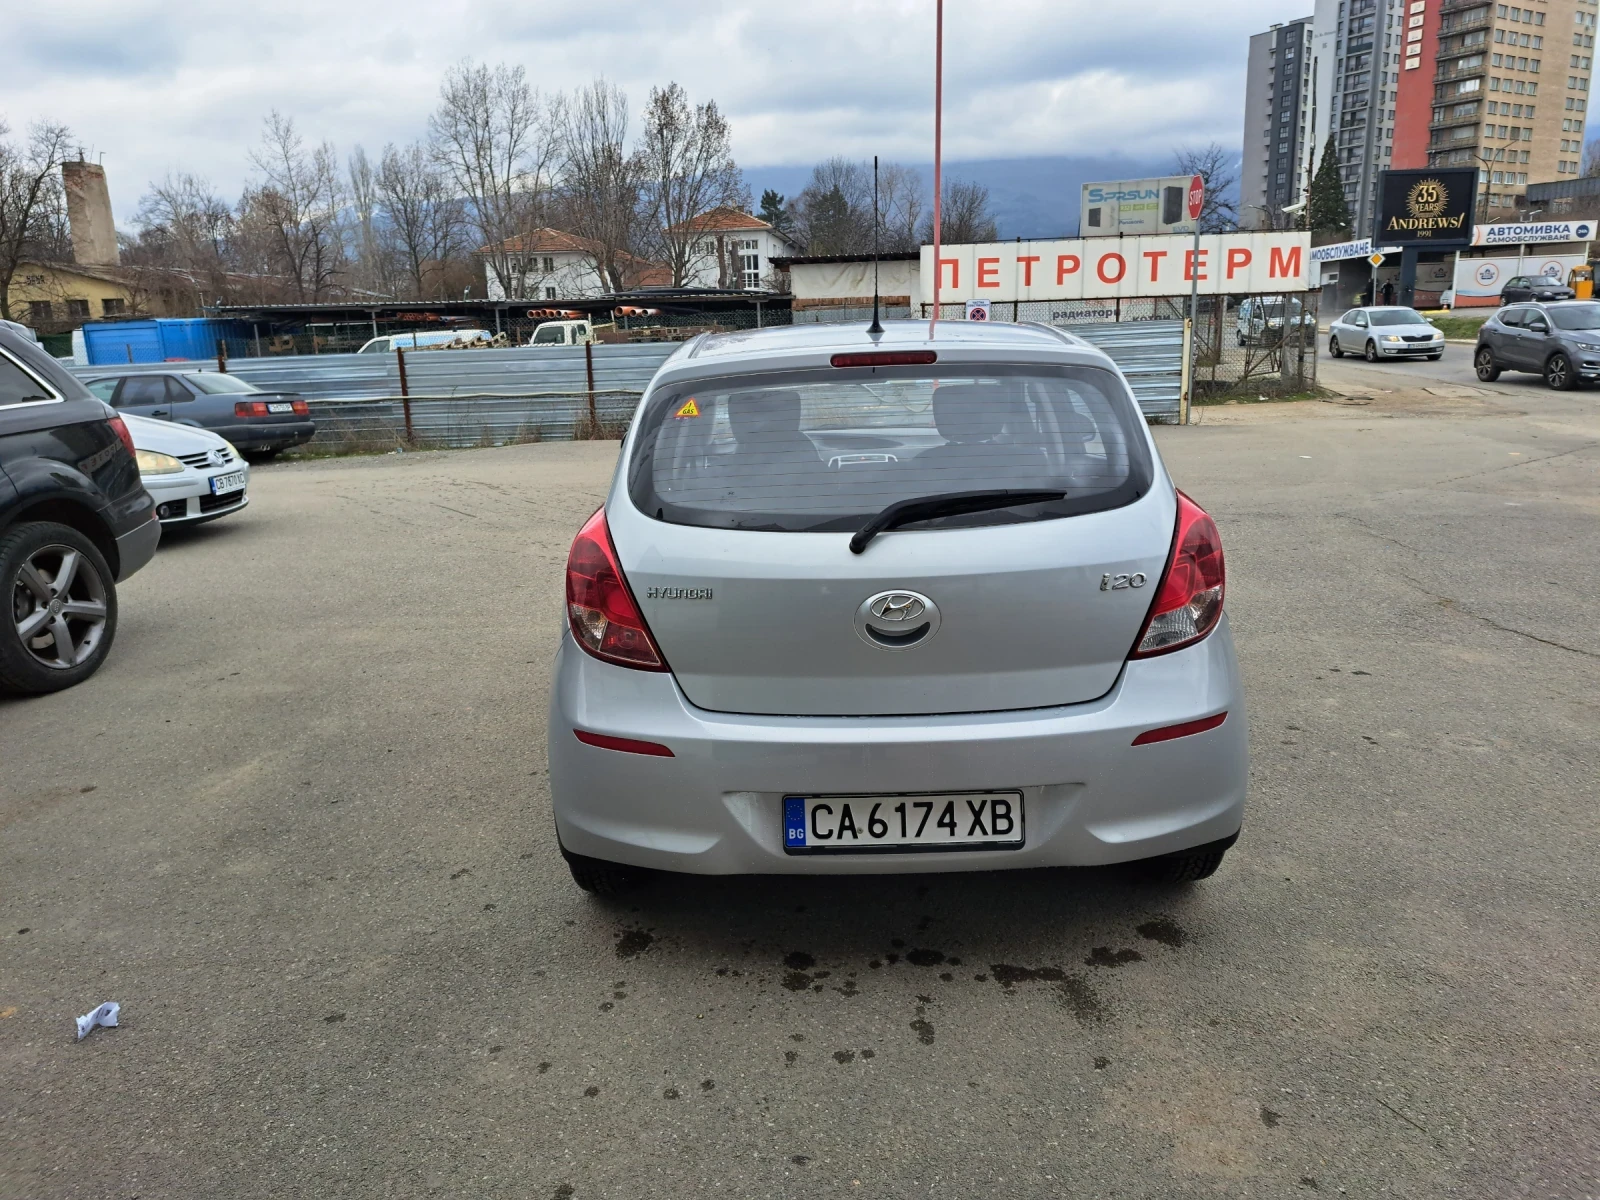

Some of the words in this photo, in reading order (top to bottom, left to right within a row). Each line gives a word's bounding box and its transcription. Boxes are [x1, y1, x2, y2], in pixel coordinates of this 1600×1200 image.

[1189, 189, 1203, 206] STOP
[1418, 185, 1437, 202] 35
[1415, 203, 1439, 211] YEARS
[1486, 234, 1571, 243] САМООБСЛУЖВАНЕ
[1487, 225, 1571, 236] АВТОМИВКА
[938, 246, 1302, 290] ПЕТРОТЕРМ
[1100, 572, 1147, 591] i20
[646, 586, 713, 599] HYUNDAI
[789, 828, 804, 840] BG
[811, 803, 858, 840] CA
[867, 800, 957, 839] 6174
[966, 799, 1014, 836] XB
